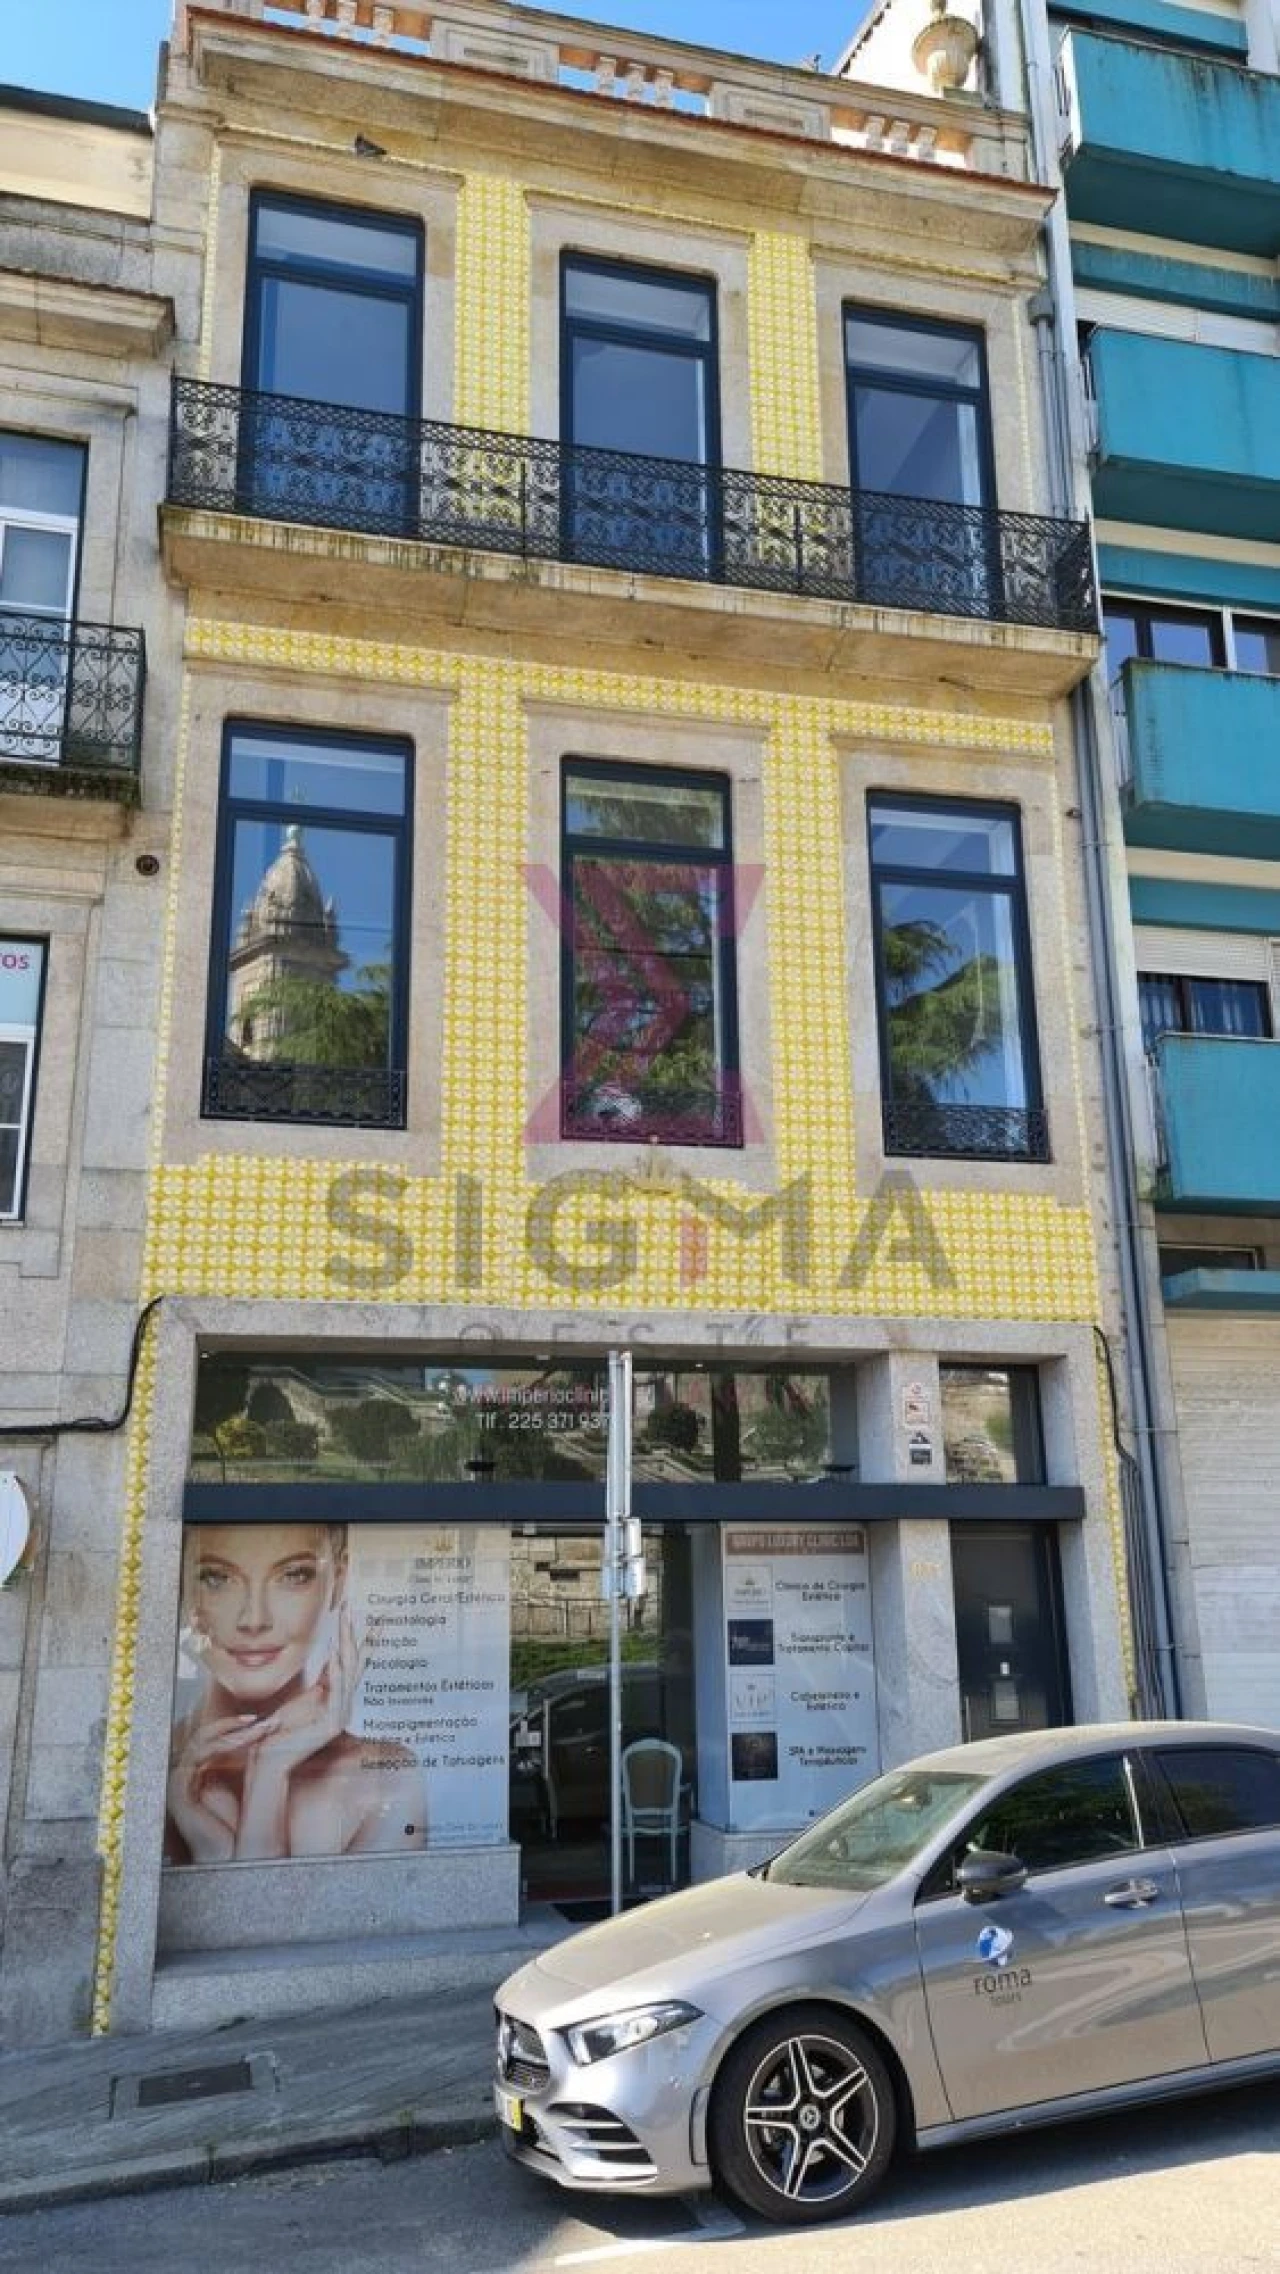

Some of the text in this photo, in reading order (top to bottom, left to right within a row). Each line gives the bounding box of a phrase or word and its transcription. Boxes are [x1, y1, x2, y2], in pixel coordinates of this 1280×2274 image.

[0, 953, 30, 969] OS
[508, 1411, 543, 1429] 225
[547, 1411, 575, 1429] 371
[366, 1614, 446, 1628] Dermatologia
[365, 1636, 417, 1649] Nutrição
[365, 1657, 428, 1670] Psicologia
[363, 1681, 437, 1693] Tratamentos
[423, 1754, 437, 1768] de
[972, 1968, 1031, 1995] roma
